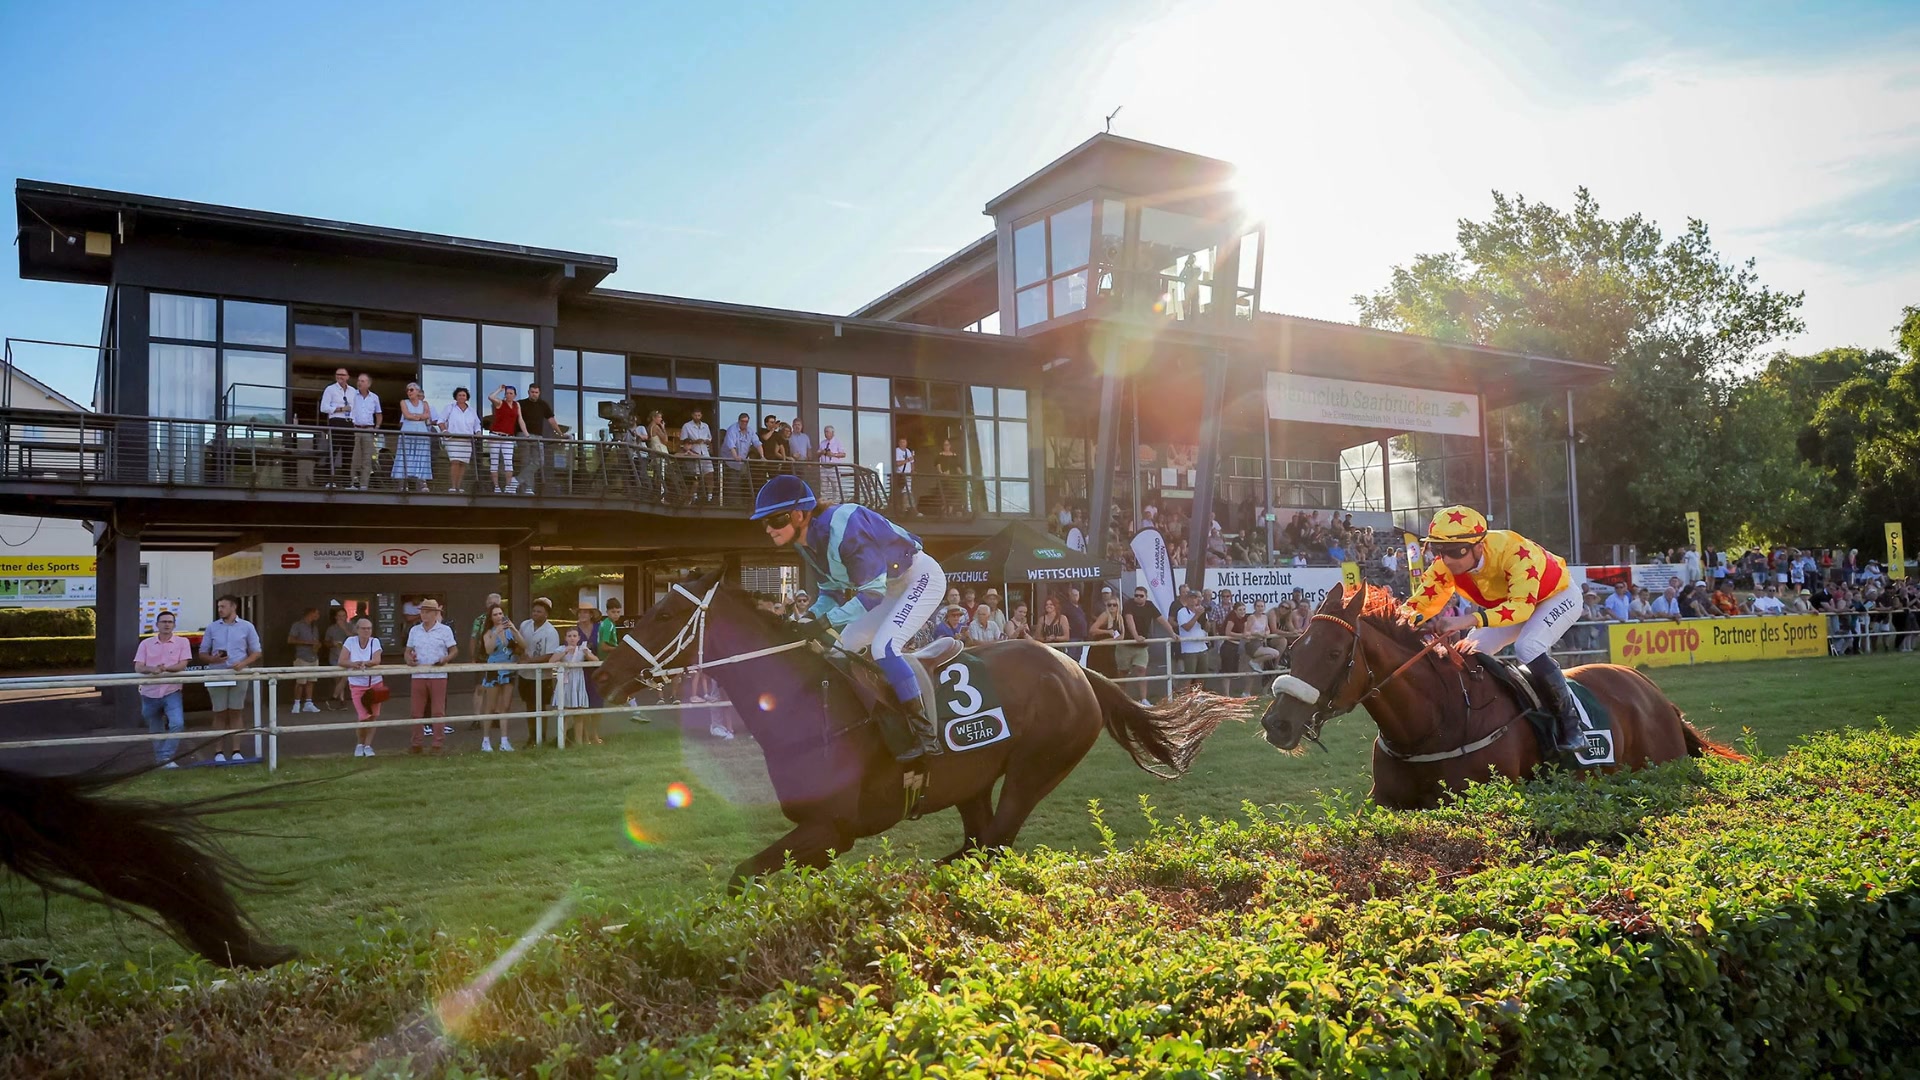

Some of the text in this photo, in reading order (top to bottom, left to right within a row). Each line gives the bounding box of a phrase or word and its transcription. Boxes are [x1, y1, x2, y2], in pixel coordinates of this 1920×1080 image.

[1352, 390, 1439, 416] Saarbrücken
[0, 563, 22, 571] tner
[26, 562, 44, 571] des
[47, 562, 80, 573] Sports
[382, 555, 408, 566] LBS
[944, 570, 989, 583] TTSCHULE
[1027, 566, 1101, 580] WETTSCHULE
[1217, 571, 1292, 586] Mit Herzblut
[1211, 589, 1279, 605] Pfrdesport
[893, 603, 914, 628] Alina
[1549, 598, 1575, 622] BRAYE
[1646, 622, 1818, 654] LOTTO Partner des Sports
[939, 662, 983, 716] 3
[956, 720, 985, 735] WETT
[966, 727, 994, 742] STAR
[1587, 737, 1600, 747] ETT
[1589, 746, 1606, 756] STAR
